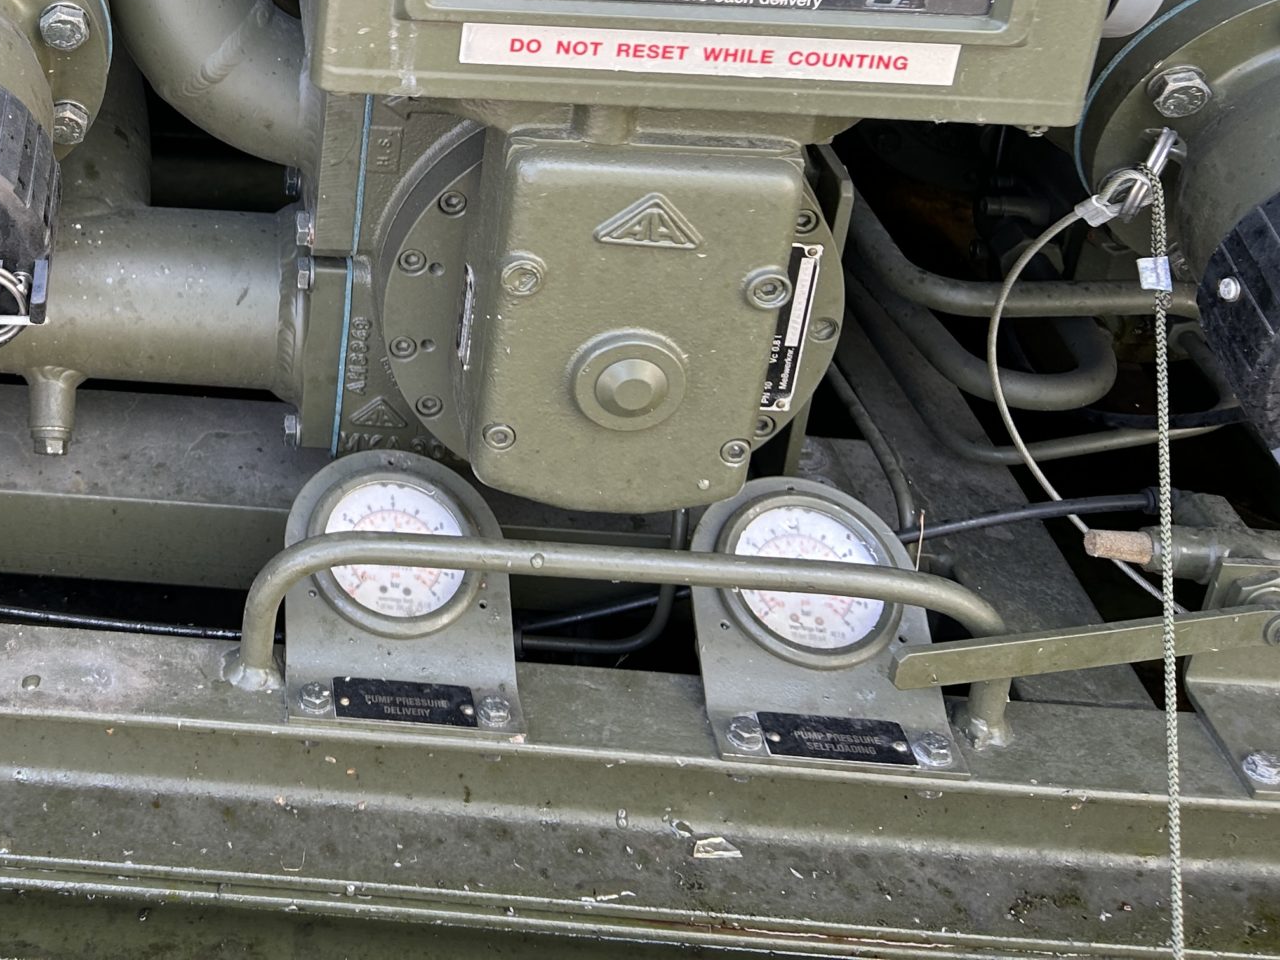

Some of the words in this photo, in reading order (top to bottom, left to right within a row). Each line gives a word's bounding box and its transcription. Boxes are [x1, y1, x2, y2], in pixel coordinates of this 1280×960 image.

[509, 38, 542, 54] DO
[556, 40, 603, 57] NOT
[616, 43, 690, 61] RESET
[703, 46, 775, 65] WHILE
[788, 50, 909, 71] COUNTING
[365, 693, 394, 705] PUMP
[396, 696, 449, 709] PRESSURE
[384, 705, 431, 717] DELIVERY
[794, 729, 825, 741] PUMP
[826, 732, 882, 745] PRESSURE
[806, 741, 877, 755] SELFLOADING
